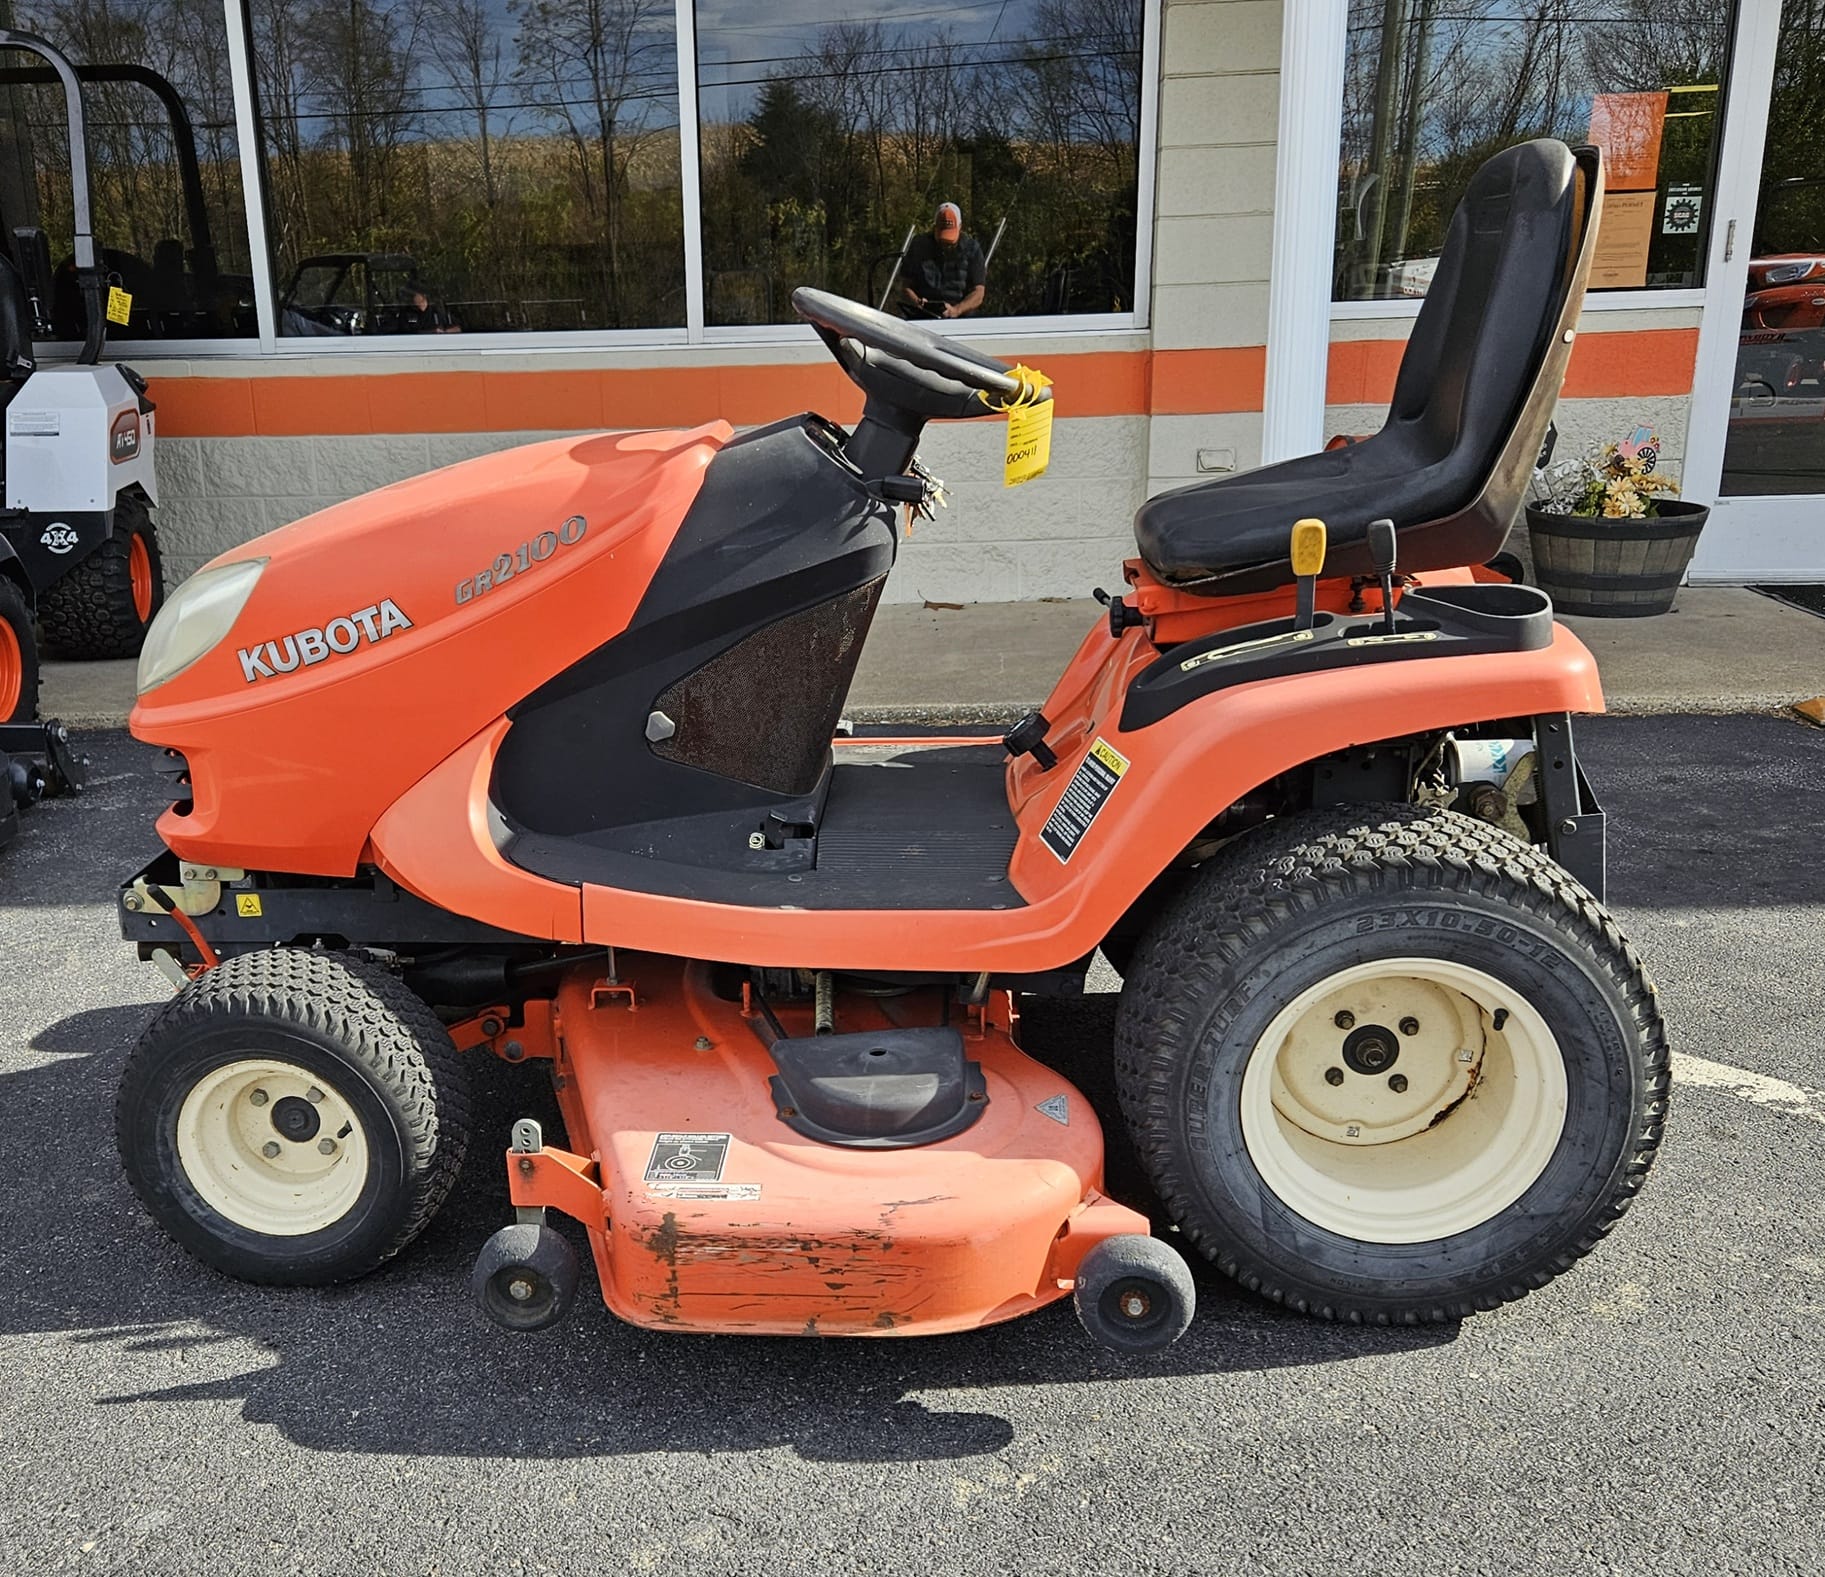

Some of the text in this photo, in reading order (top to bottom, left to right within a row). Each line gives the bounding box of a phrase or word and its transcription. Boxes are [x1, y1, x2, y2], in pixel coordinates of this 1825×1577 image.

[454, 515, 587, 606] GR2100
[237, 598, 415, 683] KUBOTA
[1098, 747, 1122, 771] CAUTION
[1356, 910, 1563, 969] 23X10.50-12
[1204, 982, 1251, 1049] TURF
